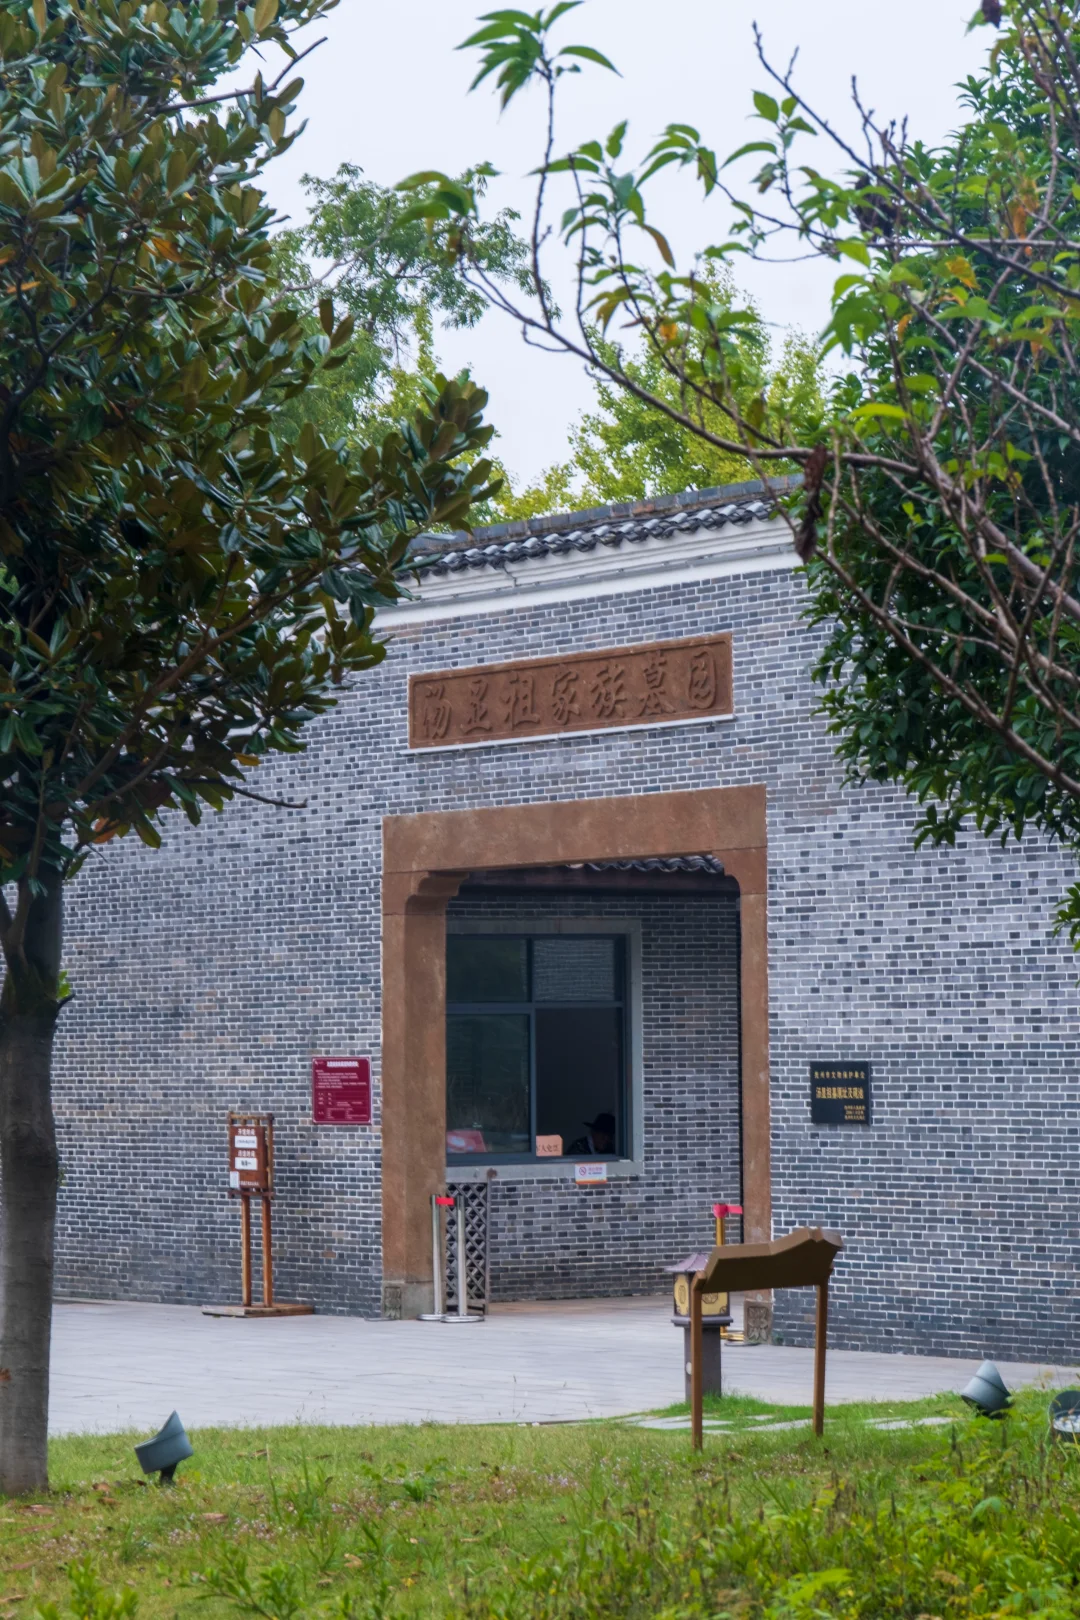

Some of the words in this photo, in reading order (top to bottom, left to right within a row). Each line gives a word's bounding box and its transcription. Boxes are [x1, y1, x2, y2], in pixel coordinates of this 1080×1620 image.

[422, 646, 718, 740] 汤显祖家族墓园
